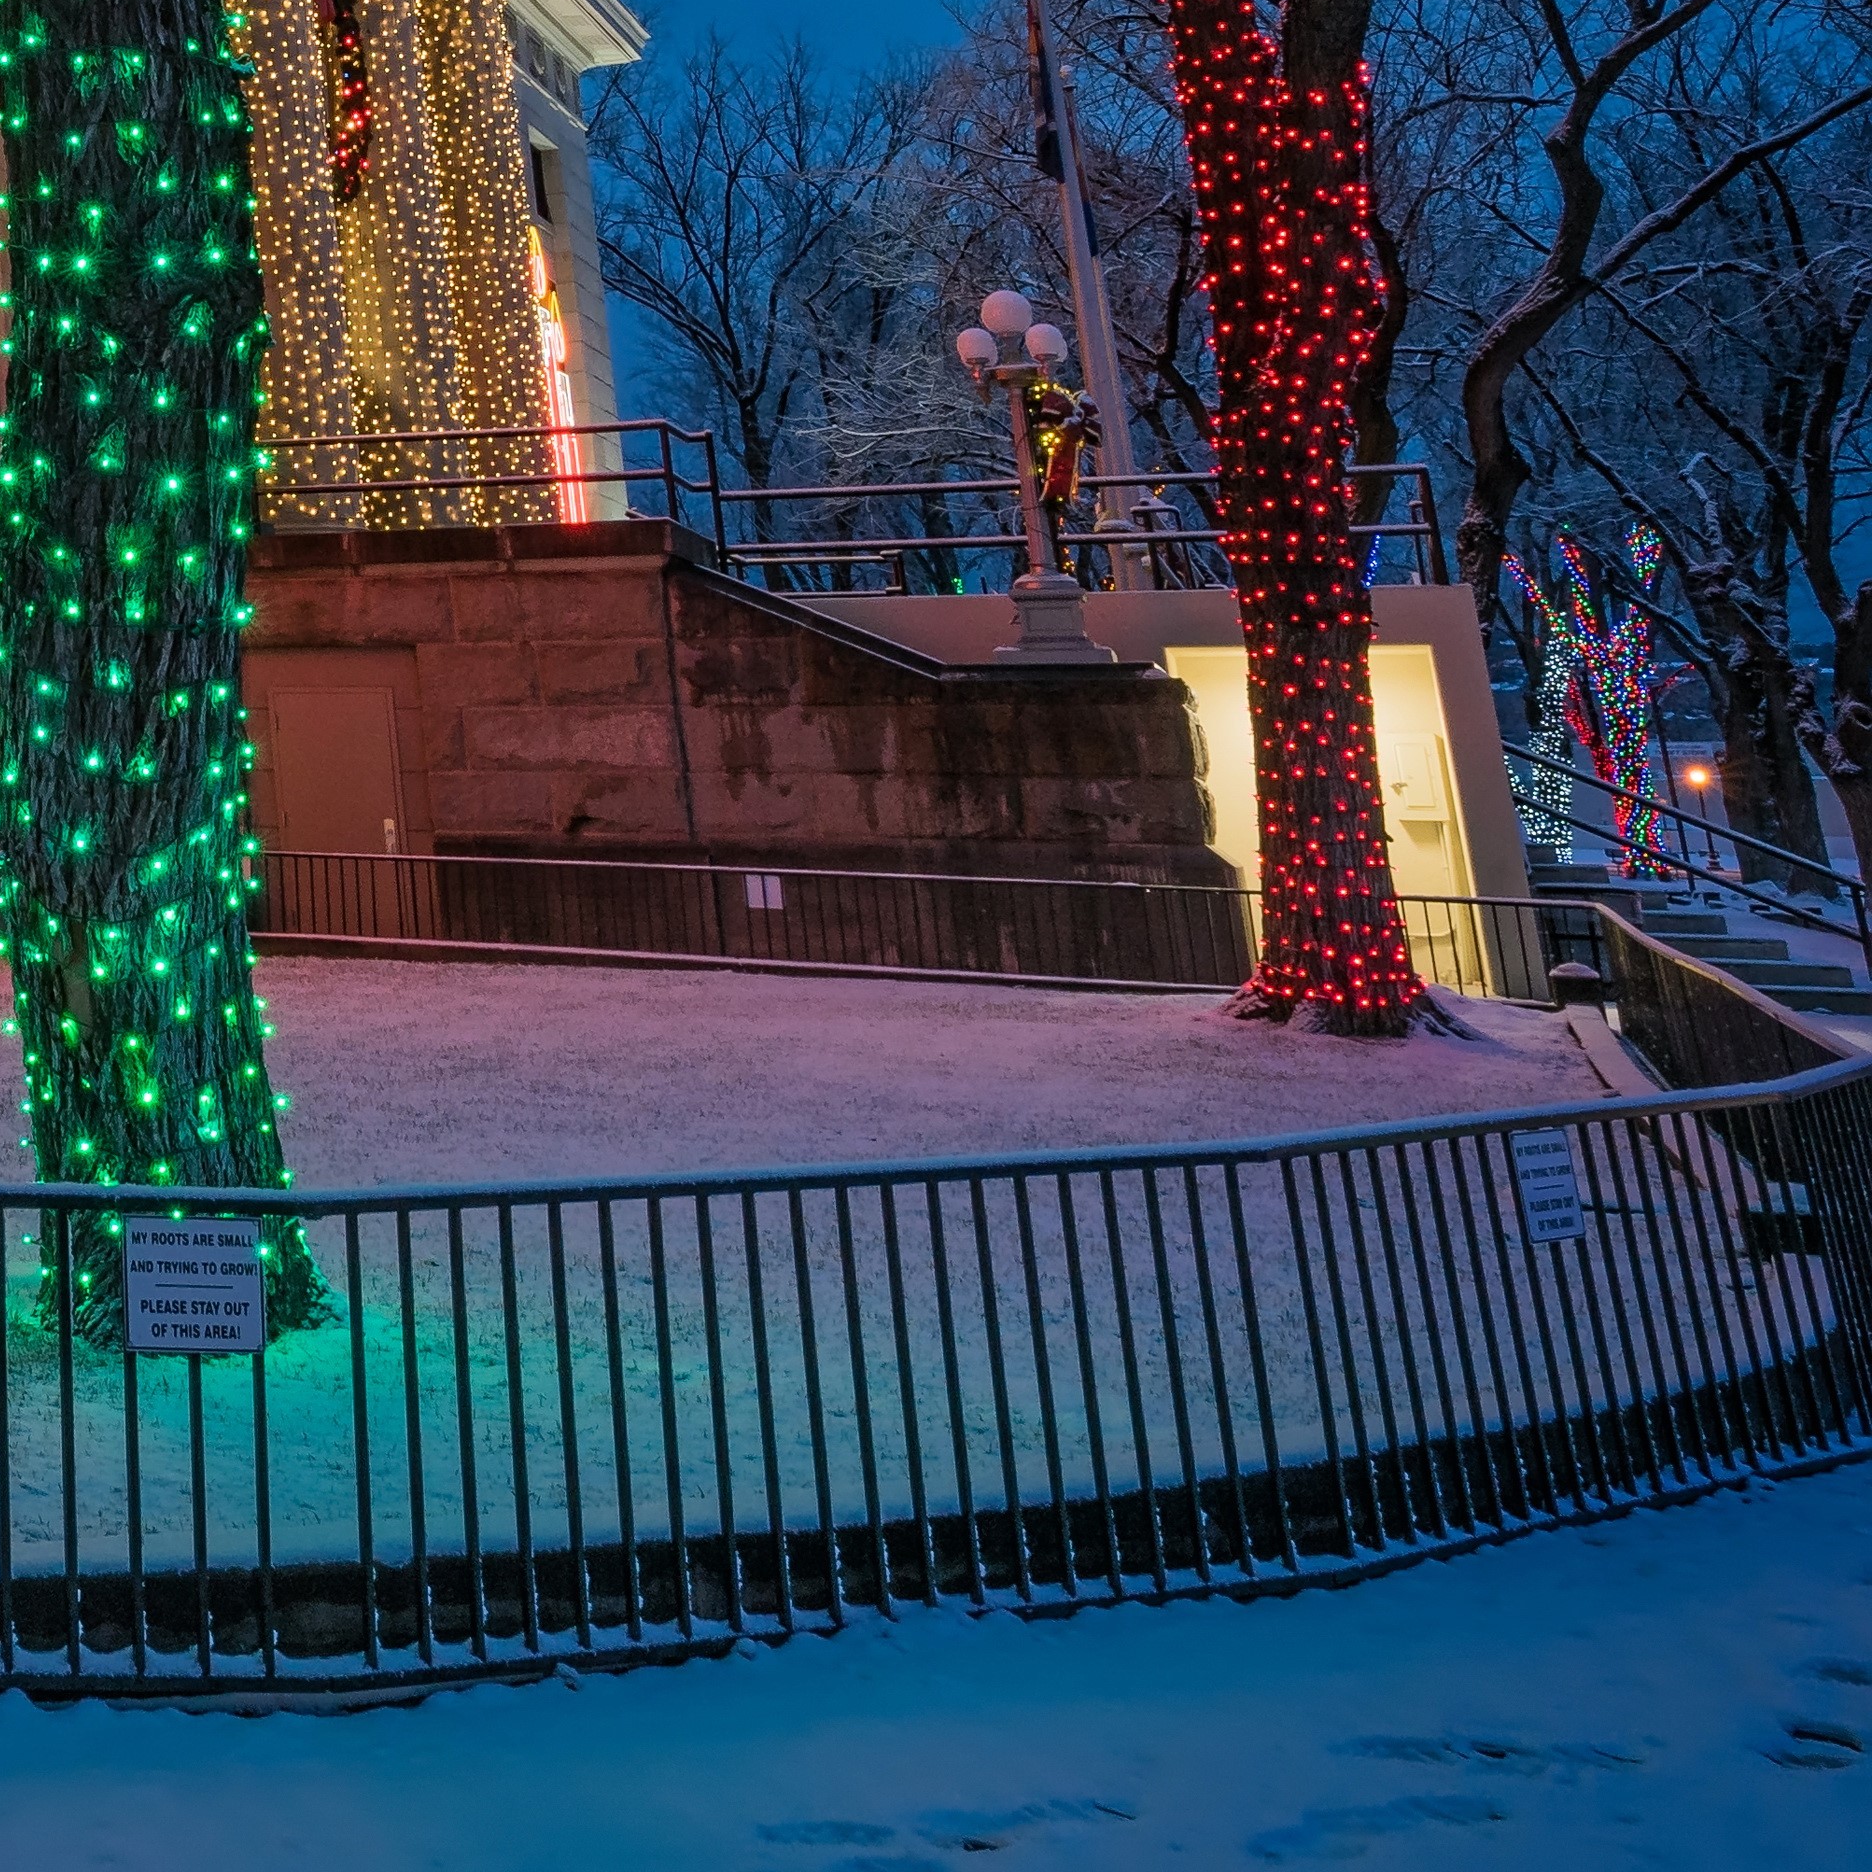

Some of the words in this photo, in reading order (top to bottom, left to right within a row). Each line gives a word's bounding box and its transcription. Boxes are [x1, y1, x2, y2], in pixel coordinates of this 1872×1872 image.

[131, 1232, 148, 1244] MY
[151, 1233, 190, 1246] ROOTS
[192, 1234, 215, 1246] ARE
[217, 1235, 254, 1247] SMALL
[129, 1260, 154, 1272] AND
[156, 1261, 199, 1274] TRYING
[201, 1262, 218, 1275] TO
[219, 1263, 258, 1276] GROW!
[140, 1300, 188, 1314] PLEASE
[190, 1301, 221, 1315] STAY
[223, 1302, 250, 1316] OUT
[151, 1323, 168, 1337] OF
[170, 1324, 201, 1338] THIS
[204, 1325, 241, 1339] AREA!
